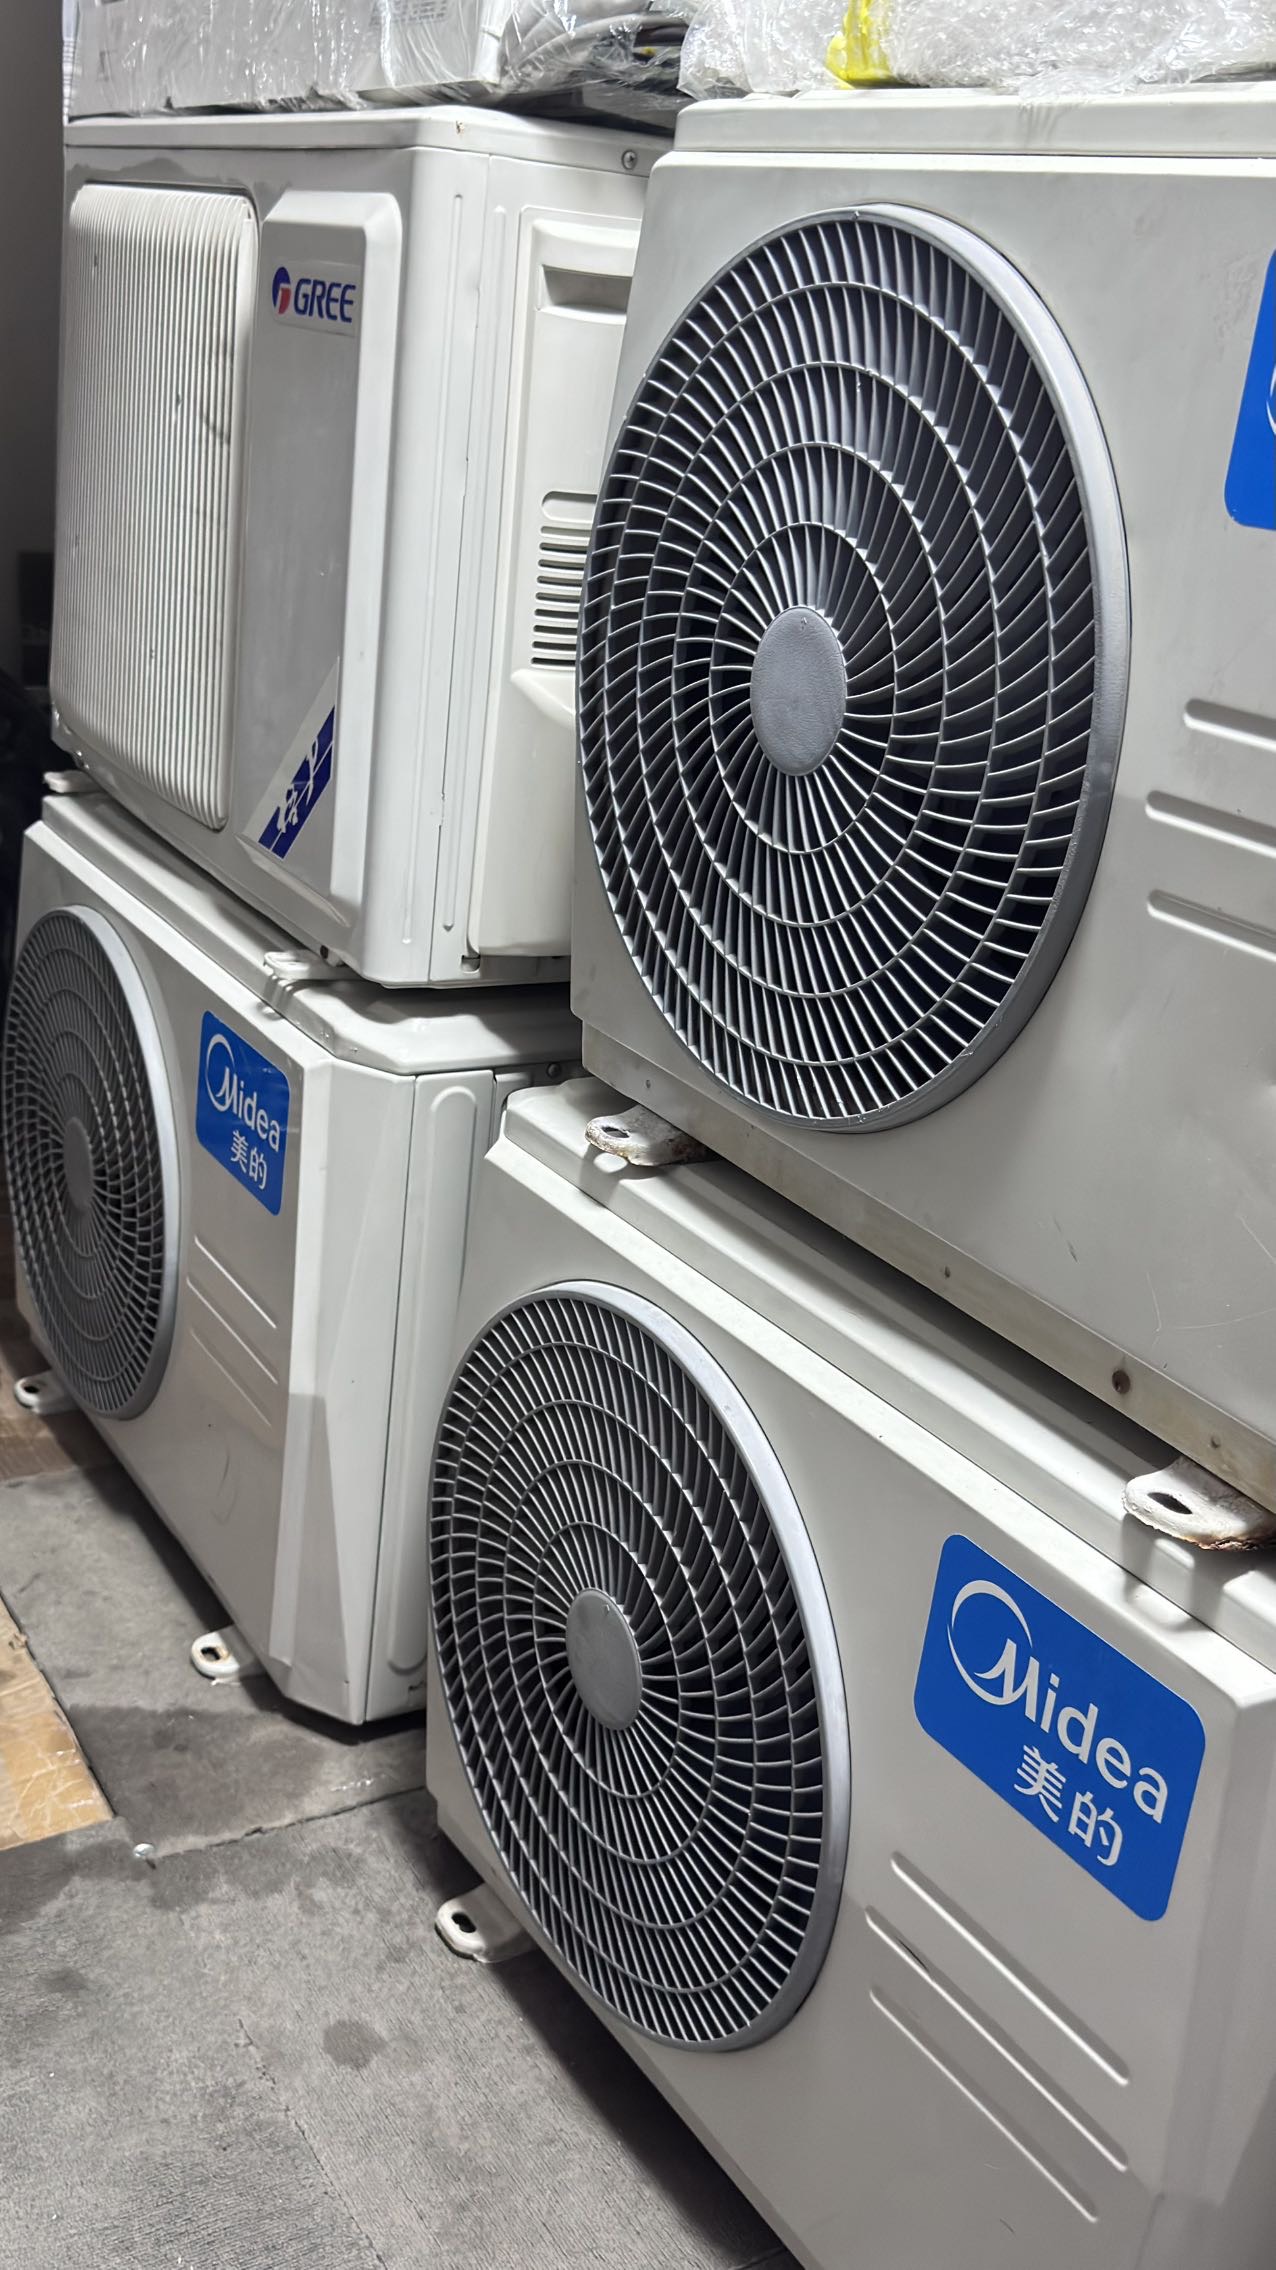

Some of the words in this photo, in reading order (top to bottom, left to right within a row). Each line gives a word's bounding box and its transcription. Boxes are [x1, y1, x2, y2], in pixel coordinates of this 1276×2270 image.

[294, 278, 356, 323] GREE
[205, 1033, 281, 1153] Midea
[230, 1129, 268, 1190] 美的
[946, 1579, 1169, 1825] Midea
[1013, 1743, 1124, 1867] 美的
